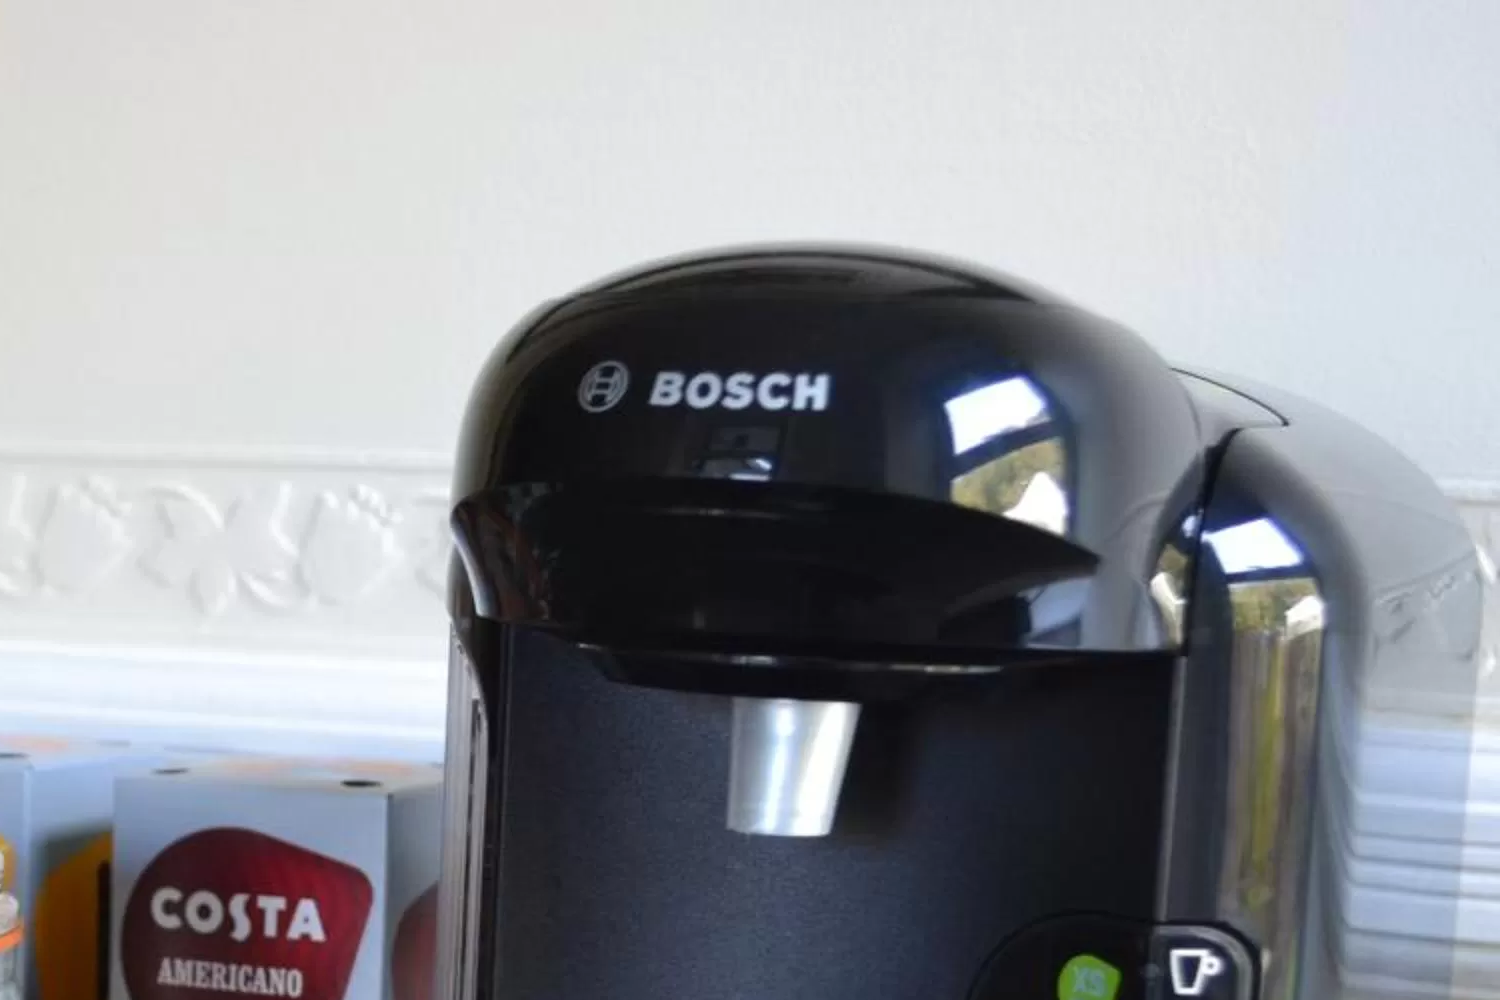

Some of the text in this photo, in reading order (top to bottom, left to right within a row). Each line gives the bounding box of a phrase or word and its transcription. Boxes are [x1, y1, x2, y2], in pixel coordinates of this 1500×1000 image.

[649, 372, 830, 411] BOSCH
[150, 887, 326, 942] COSTA
[157, 957, 304, 997] AMERICANO
